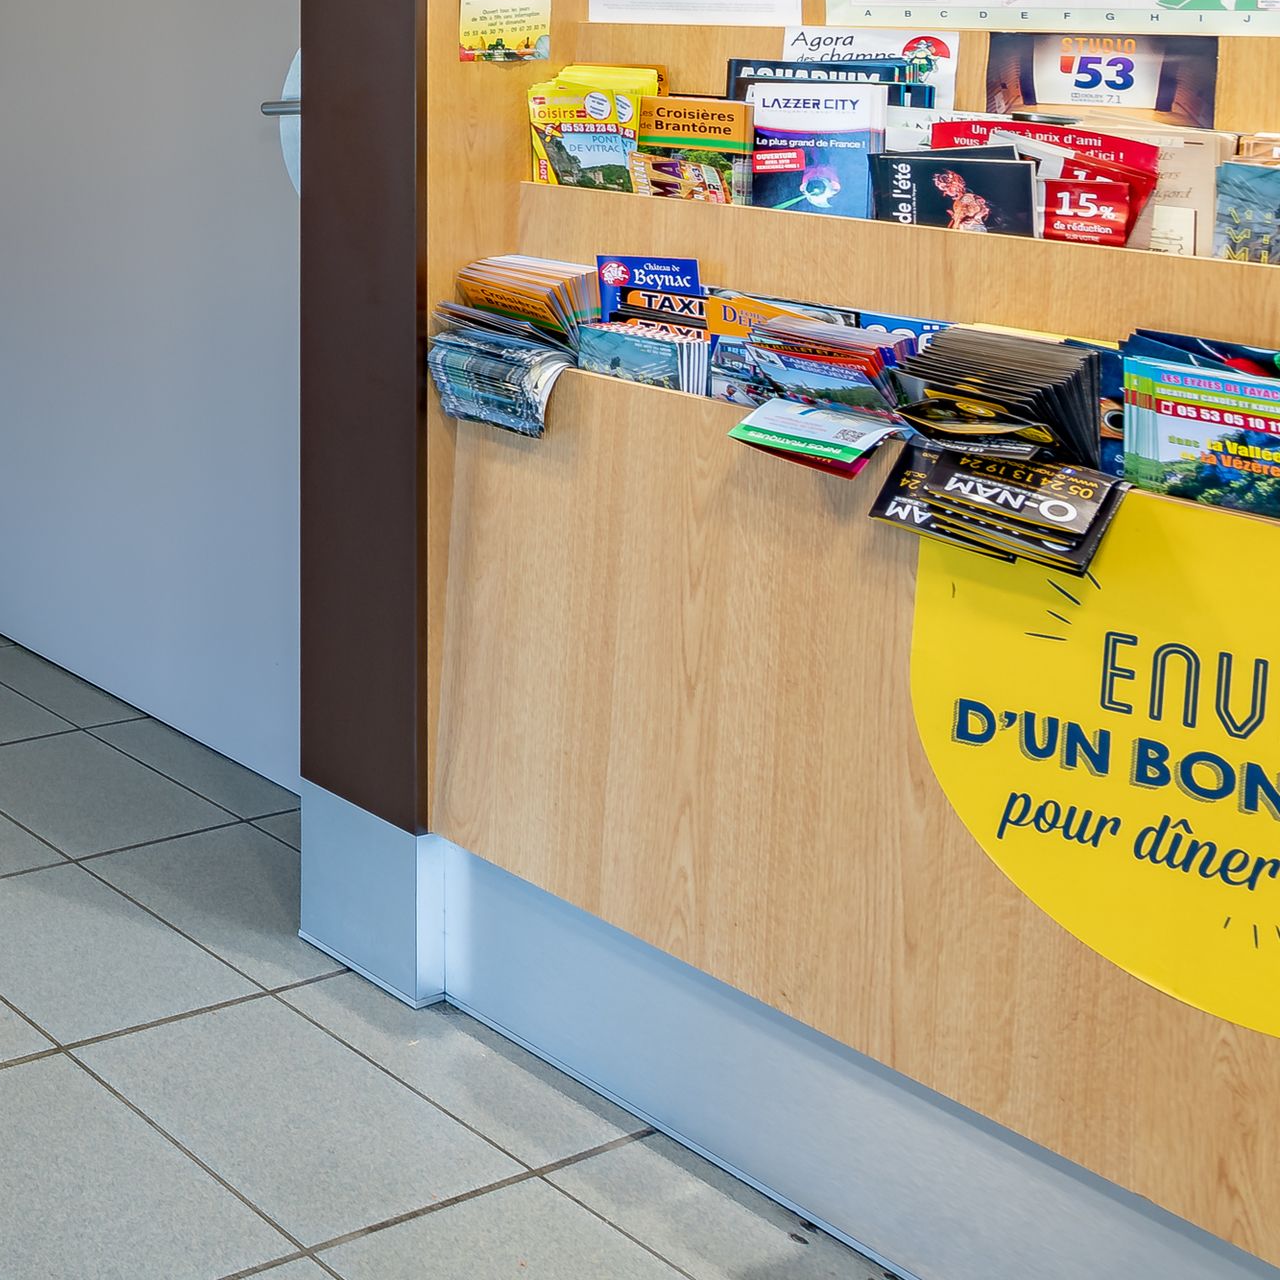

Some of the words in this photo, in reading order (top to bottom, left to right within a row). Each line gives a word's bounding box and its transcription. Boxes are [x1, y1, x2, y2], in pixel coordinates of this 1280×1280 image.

[1060, 38, 1136, 55] STUDIO
[762, 97, 821, 110] LAZZER
[824, 98, 860, 111] CITY
[656, 107, 735, 122] Croisières
[641, 121, 652, 129] de
[654, 119, 732, 135] Brantôme
[756, 137, 768, 146] Le
[770, 137, 790, 147] plus
[792, 139, 815, 149] grand
[816, 139, 827, 147] de
[829, 139, 861, 148] France
[1053, 220, 1066, 231] de
[1067, 222, 1112, 235] réduction
[634, 269, 691, 289] Beynac
[641, 292, 705, 316] TAXI
[1160, 372, 1181, 384] LES
[1183, 375, 1213, 391] EYZIES
[1215, 380, 1232, 393] DE
[945, 475, 1078, 523] O-NAM
[1099, 630, 1269, 740] ENV
[951, 697, 1112, 777] D'UN
[1129, 737, 1280, 821] BON
[996, 790, 1121, 850] pour
[1133, 814, 1280, 891] dîner
